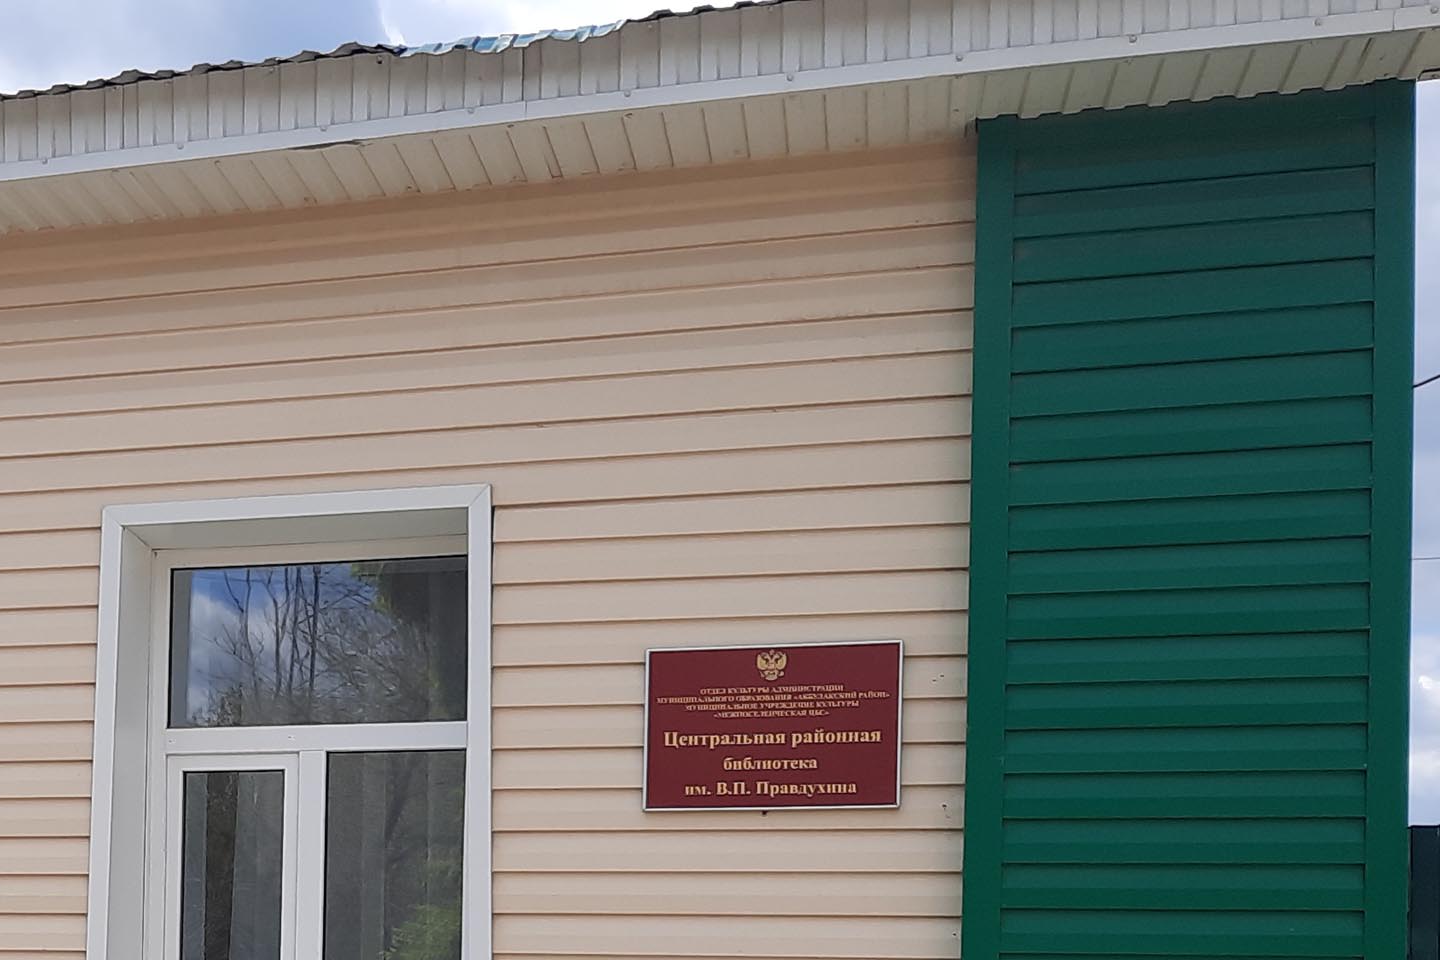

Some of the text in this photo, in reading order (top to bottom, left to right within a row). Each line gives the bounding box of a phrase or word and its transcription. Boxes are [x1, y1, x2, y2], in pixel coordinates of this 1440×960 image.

[663, 729, 882, 749] Центральная районная
[723, 756, 818, 771] библиотека
[685, 781, 857, 798] им. В.П. Правдухина
